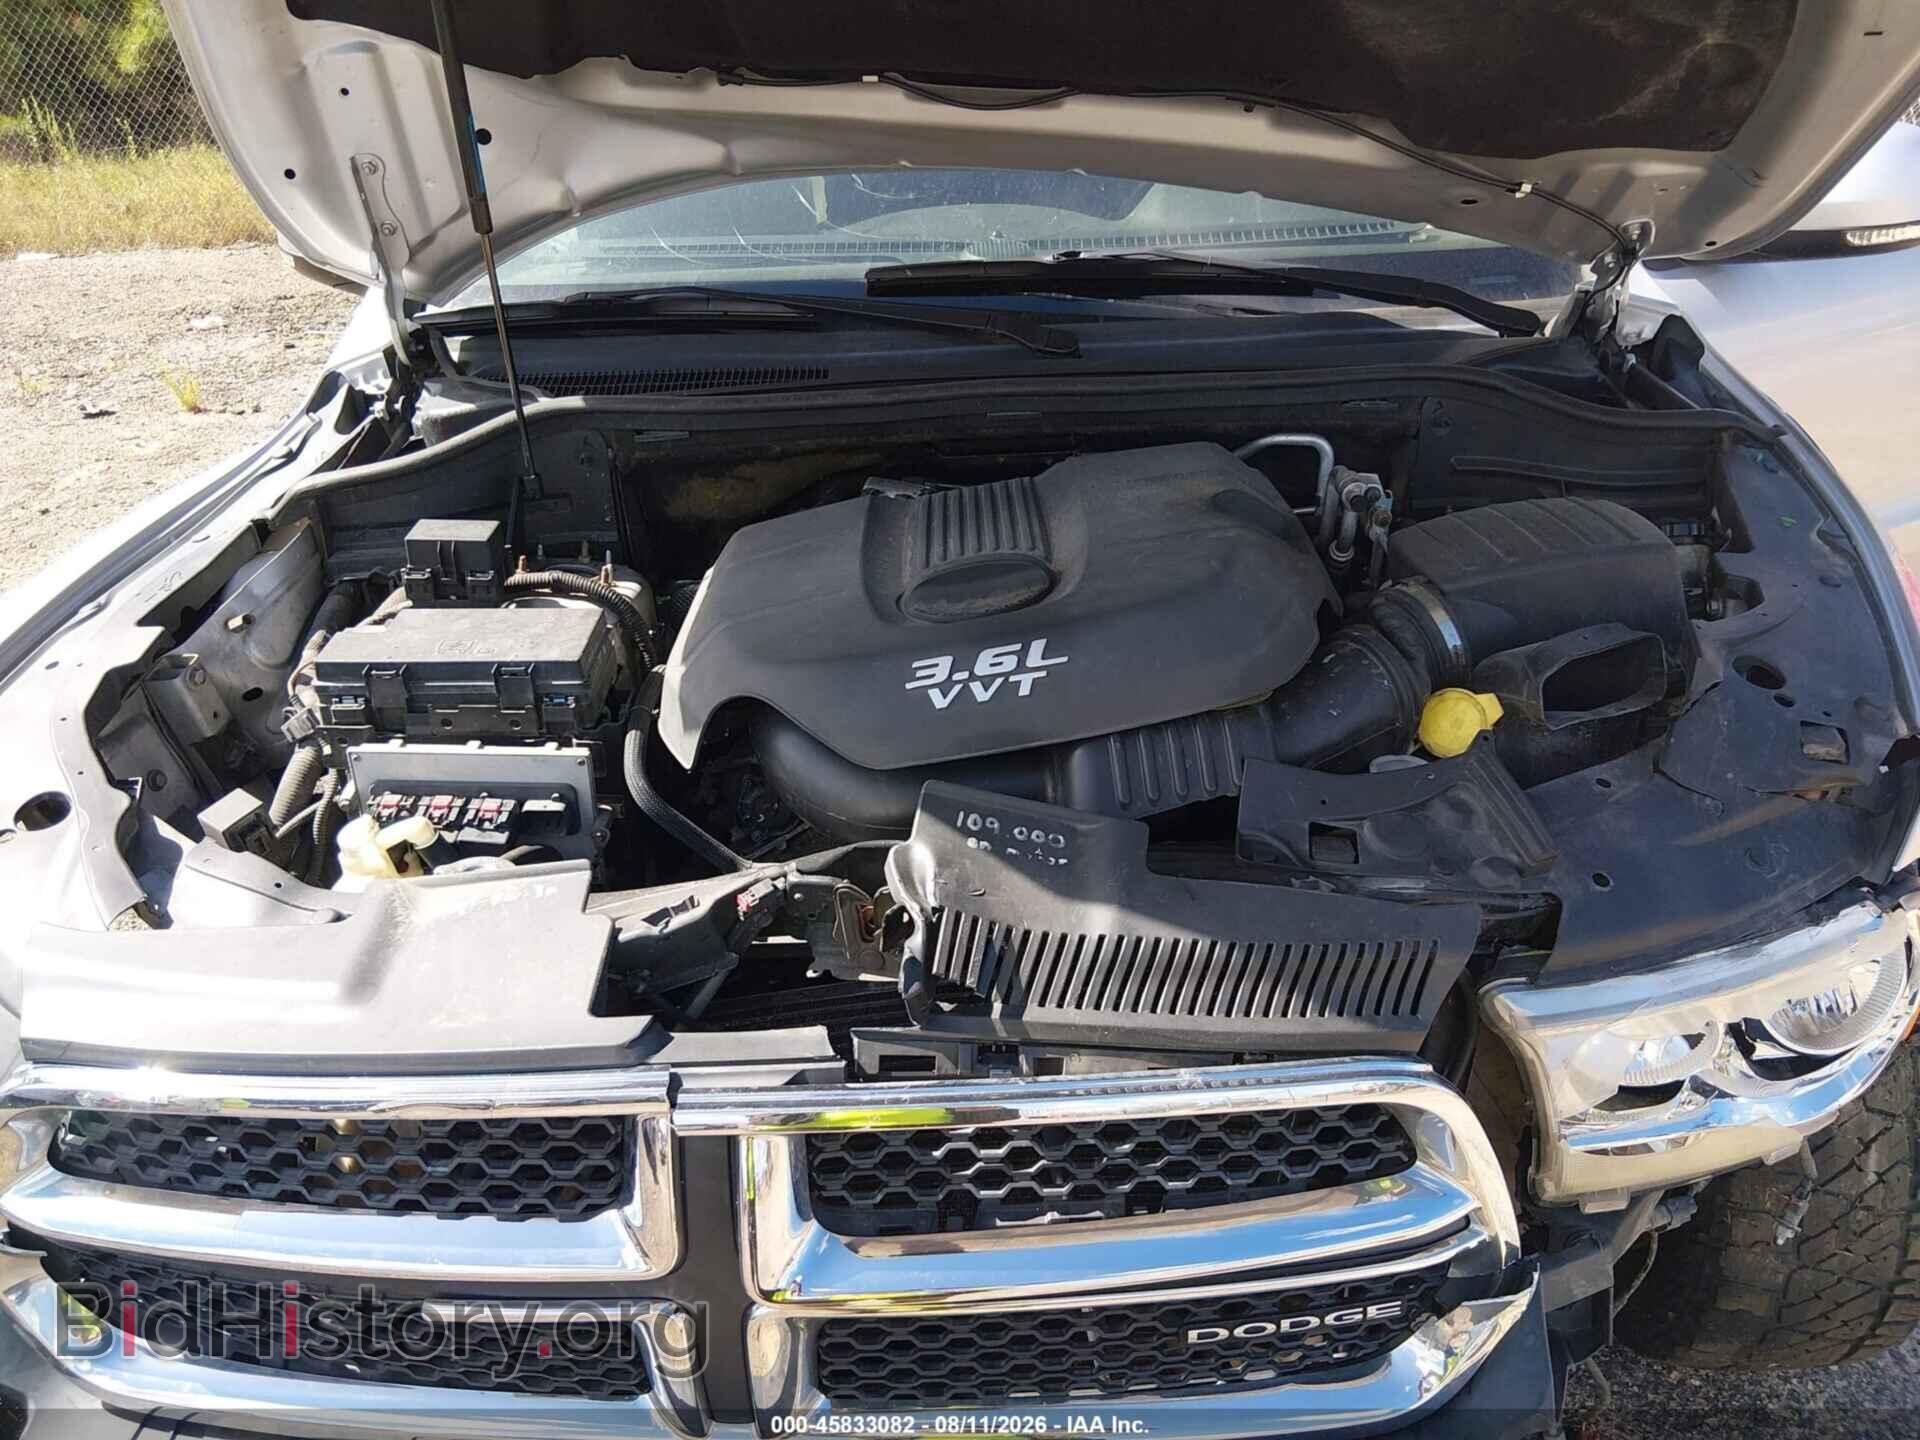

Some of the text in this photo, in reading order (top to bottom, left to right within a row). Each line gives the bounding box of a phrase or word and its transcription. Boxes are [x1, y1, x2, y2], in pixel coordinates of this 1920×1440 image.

[905, 637, 1069, 690] 3.6L
[927, 670, 1048, 710] VVT
[1187, 1300, 1402, 1345] DODGE
